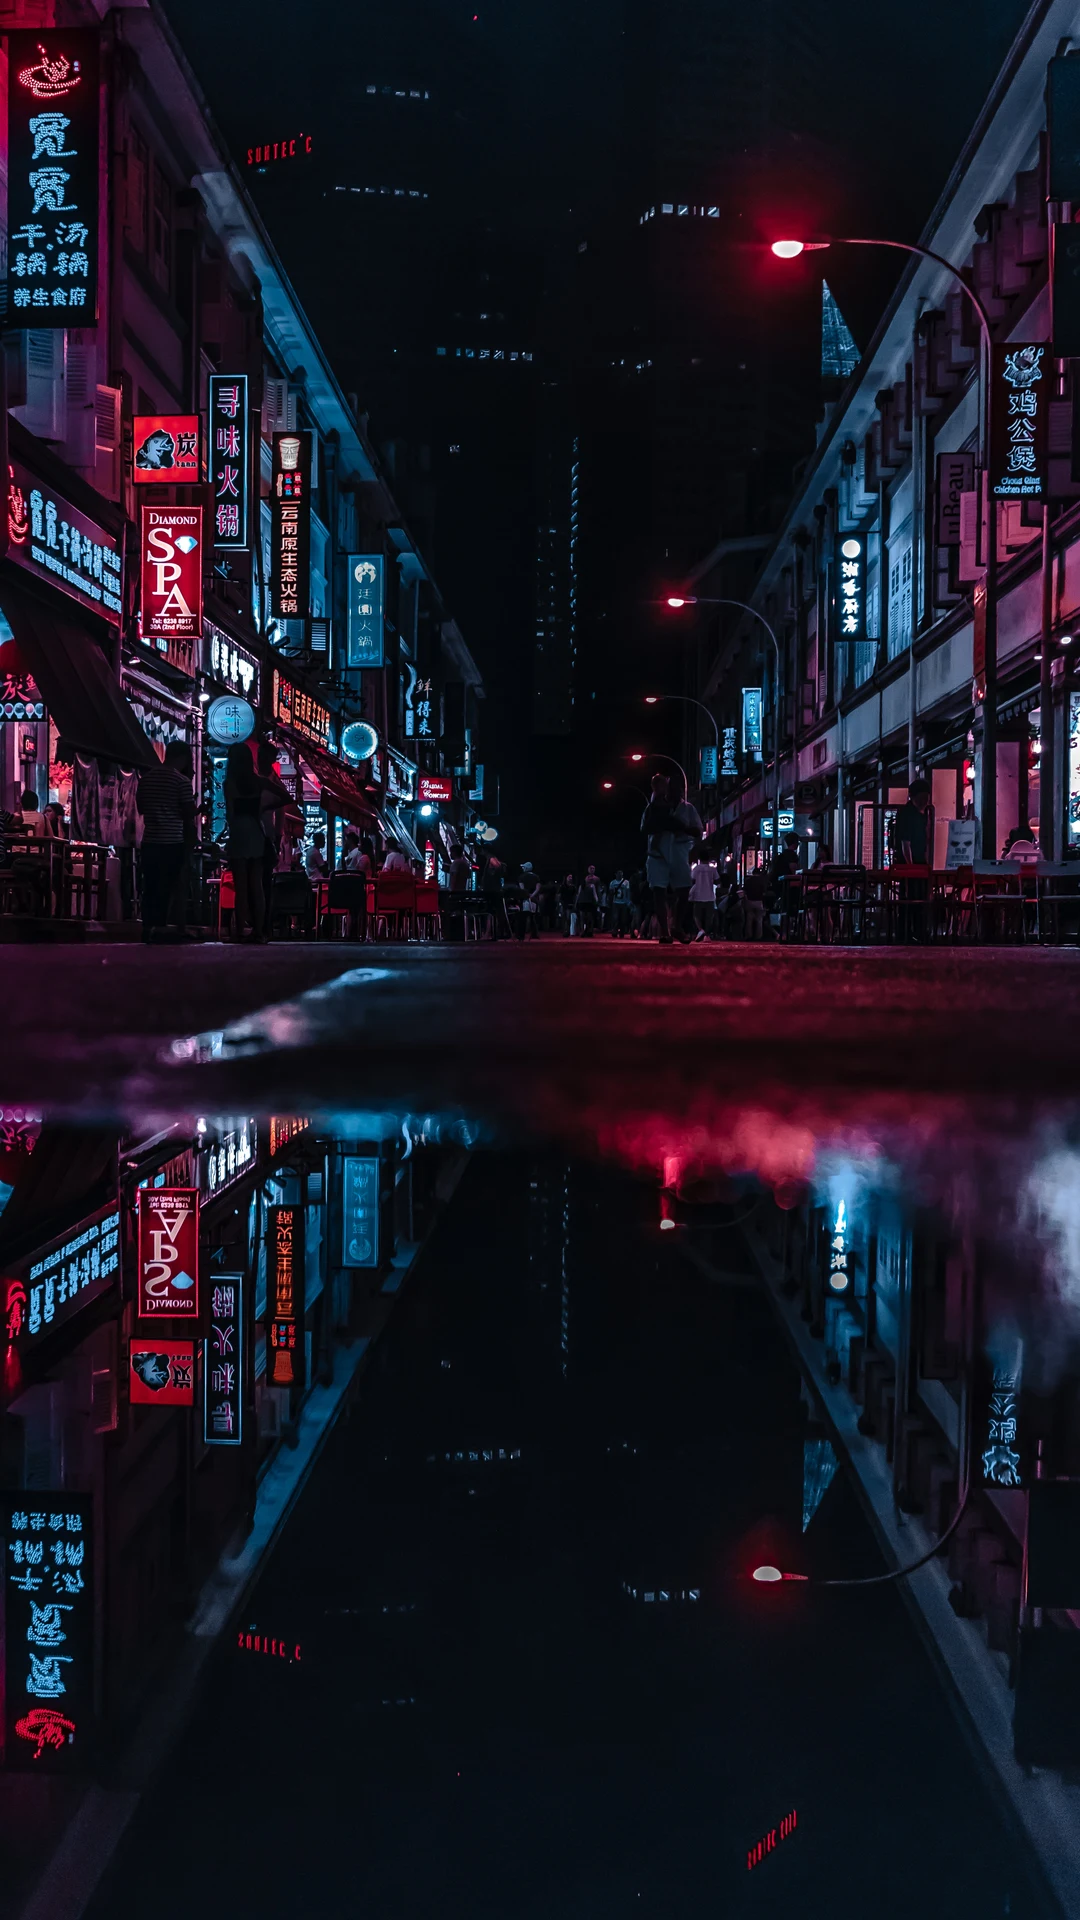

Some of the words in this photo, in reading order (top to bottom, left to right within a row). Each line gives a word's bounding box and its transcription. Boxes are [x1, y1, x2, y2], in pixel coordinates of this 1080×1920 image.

[247, 139, 296, 165] SUNTEC
[13, 286, 87, 307] 养生食府
[176, 431, 197, 457] 炭
[1007, 389, 1037, 472] 鸡公煲
[216, 385, 241, 537] 寻味火锅
[149, 512, 197, 525] DIAMOND
[146, 527, 197, 617] SPA
[280, 505, 298, 613] 云南原生态火锅
[415, 678, 433, 736] 鲜得来
